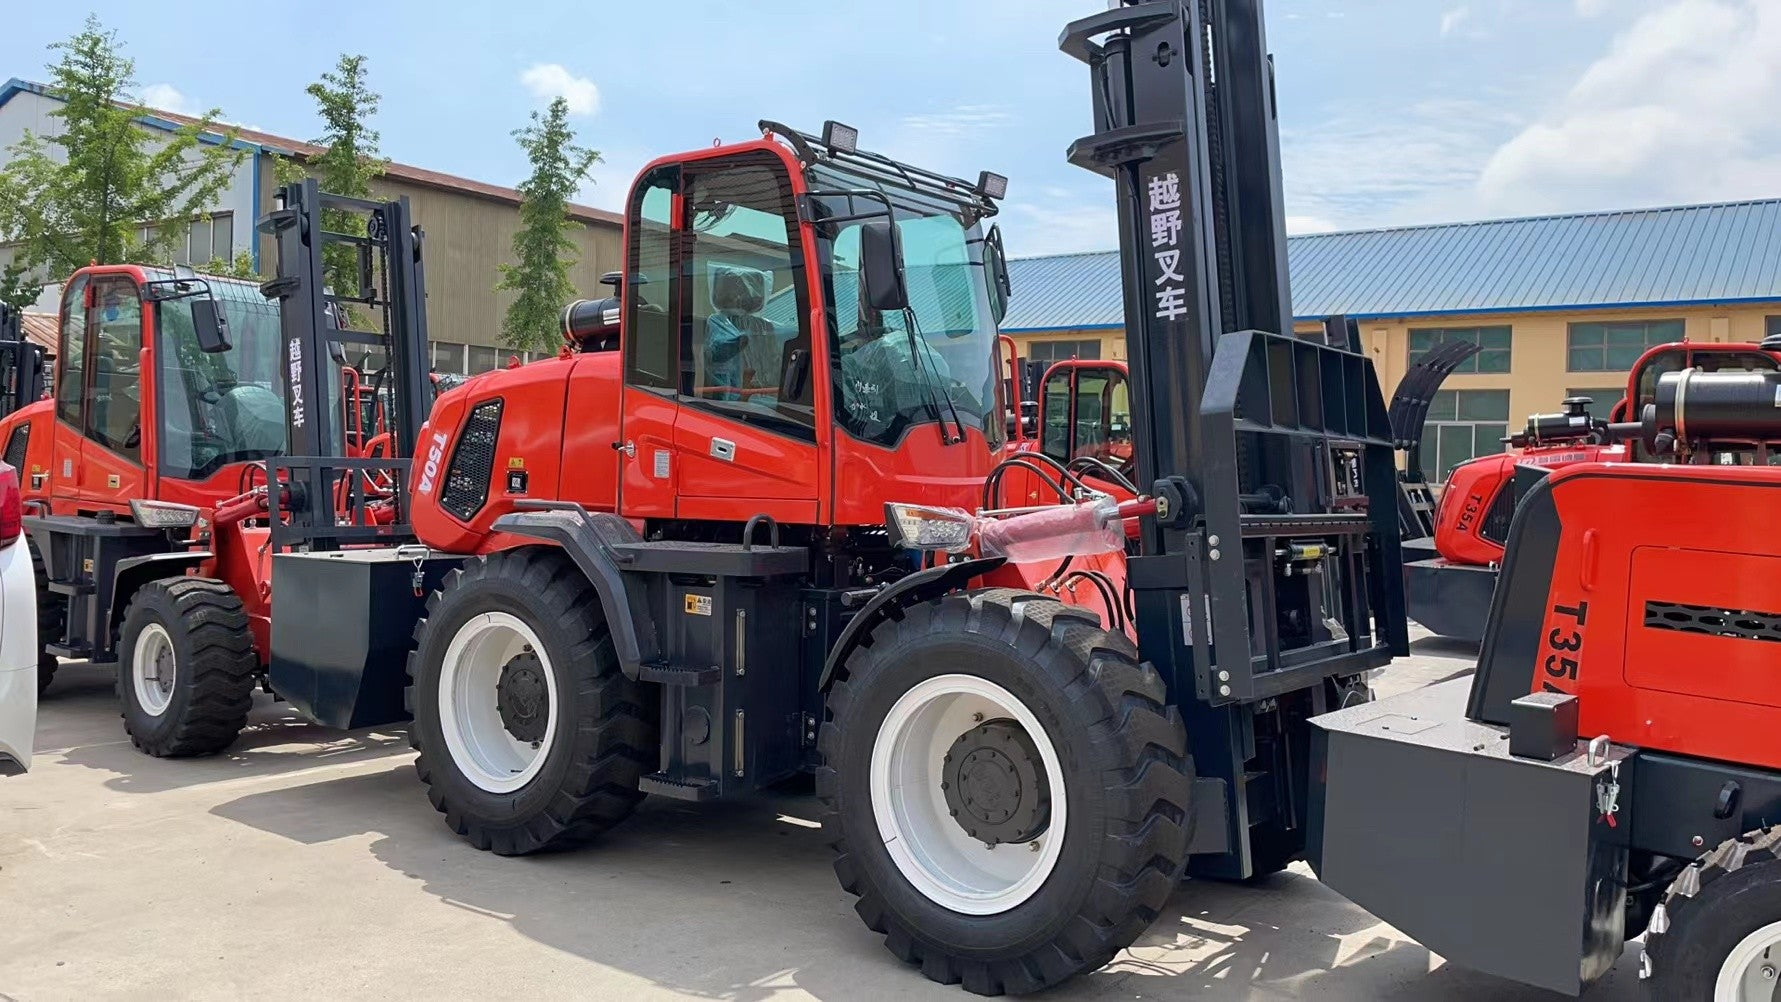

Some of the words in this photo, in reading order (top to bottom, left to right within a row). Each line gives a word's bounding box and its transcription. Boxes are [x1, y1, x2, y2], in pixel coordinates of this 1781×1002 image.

[1148, 173, 1187, 321] 越野叉车
[289, 337, 304, 427] 越野叉车
[418, 432, 448, 493] T50A
[1456, 495, 1482, 531] T35A
